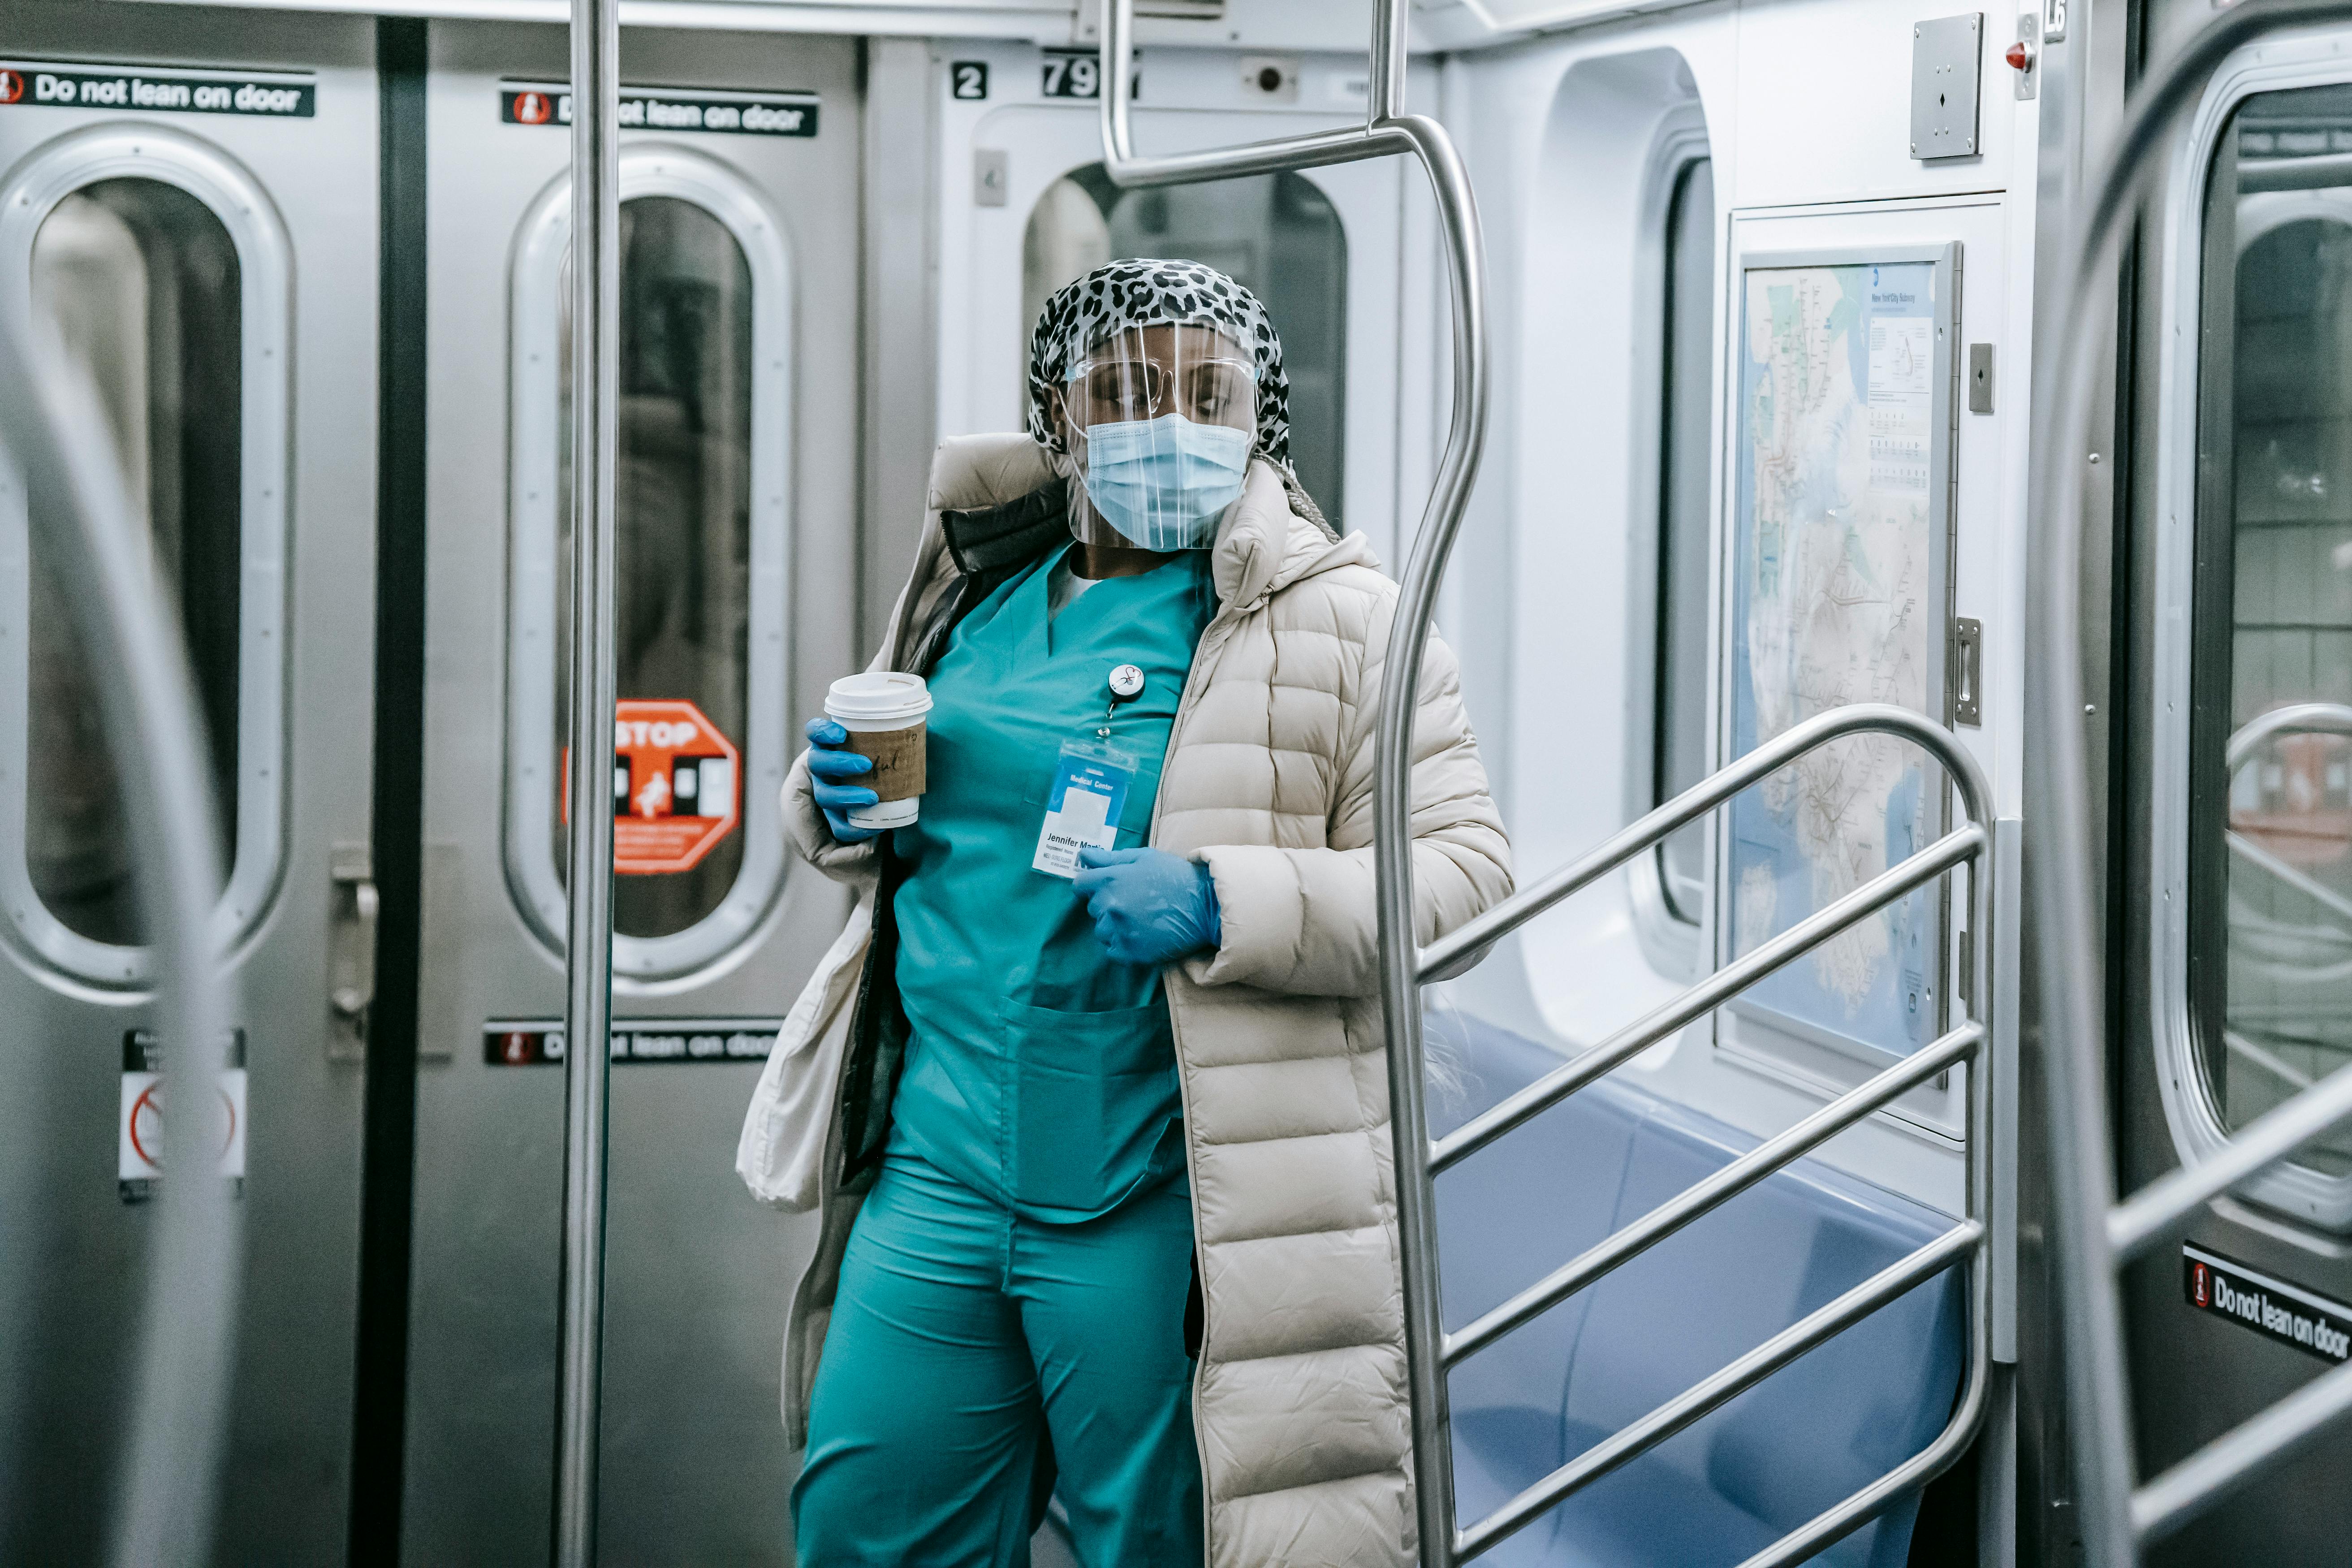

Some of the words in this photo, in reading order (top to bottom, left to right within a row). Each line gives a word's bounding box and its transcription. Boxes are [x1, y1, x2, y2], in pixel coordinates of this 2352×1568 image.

[35, 74, 77, 102] Do
[80, 79, 127, 104] not
[131, 78, 190, 108] lean
[193, 86, 230, 109] on
[234, 83, 302, 112] door
[957, 66, 982, 97] 2
[557, 96, 572, 122] D
[618, 100, 645, 125] ot
[647, 99, 703, 127] lean
[703, 106, 740, 128] on
[742, 104, 805, 131] door
[616, 721, 698, 747] STOP
[1070, 774, 1092, 786] Medical
[1094, 781, 1114, 791] Center
[1047, 833, 1079, 847] Jennifer
[2215, 1275, 2235, 1313] Do
[2236, 1292, 2260, 1323] not
[2261, 1294, 2292, 1336] lean
[2293, 1315, 2313, 1345] on
[2314, 1317, 2350, 1359] door
